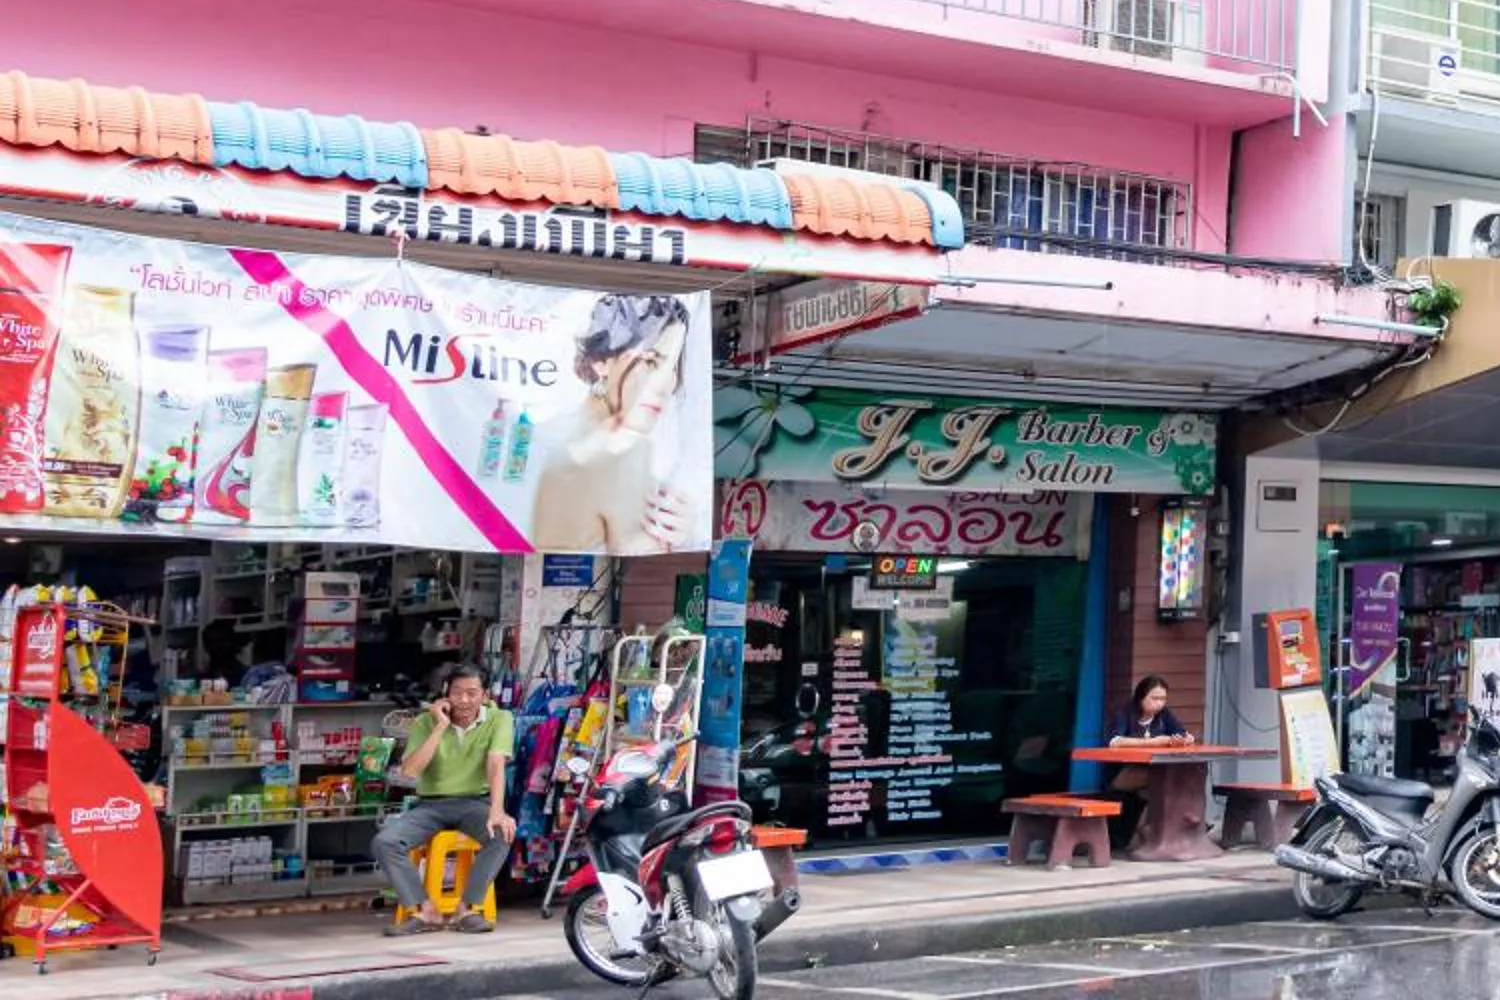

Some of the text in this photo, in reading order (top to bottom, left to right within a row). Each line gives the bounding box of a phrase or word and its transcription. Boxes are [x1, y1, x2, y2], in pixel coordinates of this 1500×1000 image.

[1017, 408, 1143, 447] Barber
[1149, 423, 1177, 456] &
[1017, 450, 1115, 487] Salon
[880, 556, 932, 574] OPEN
